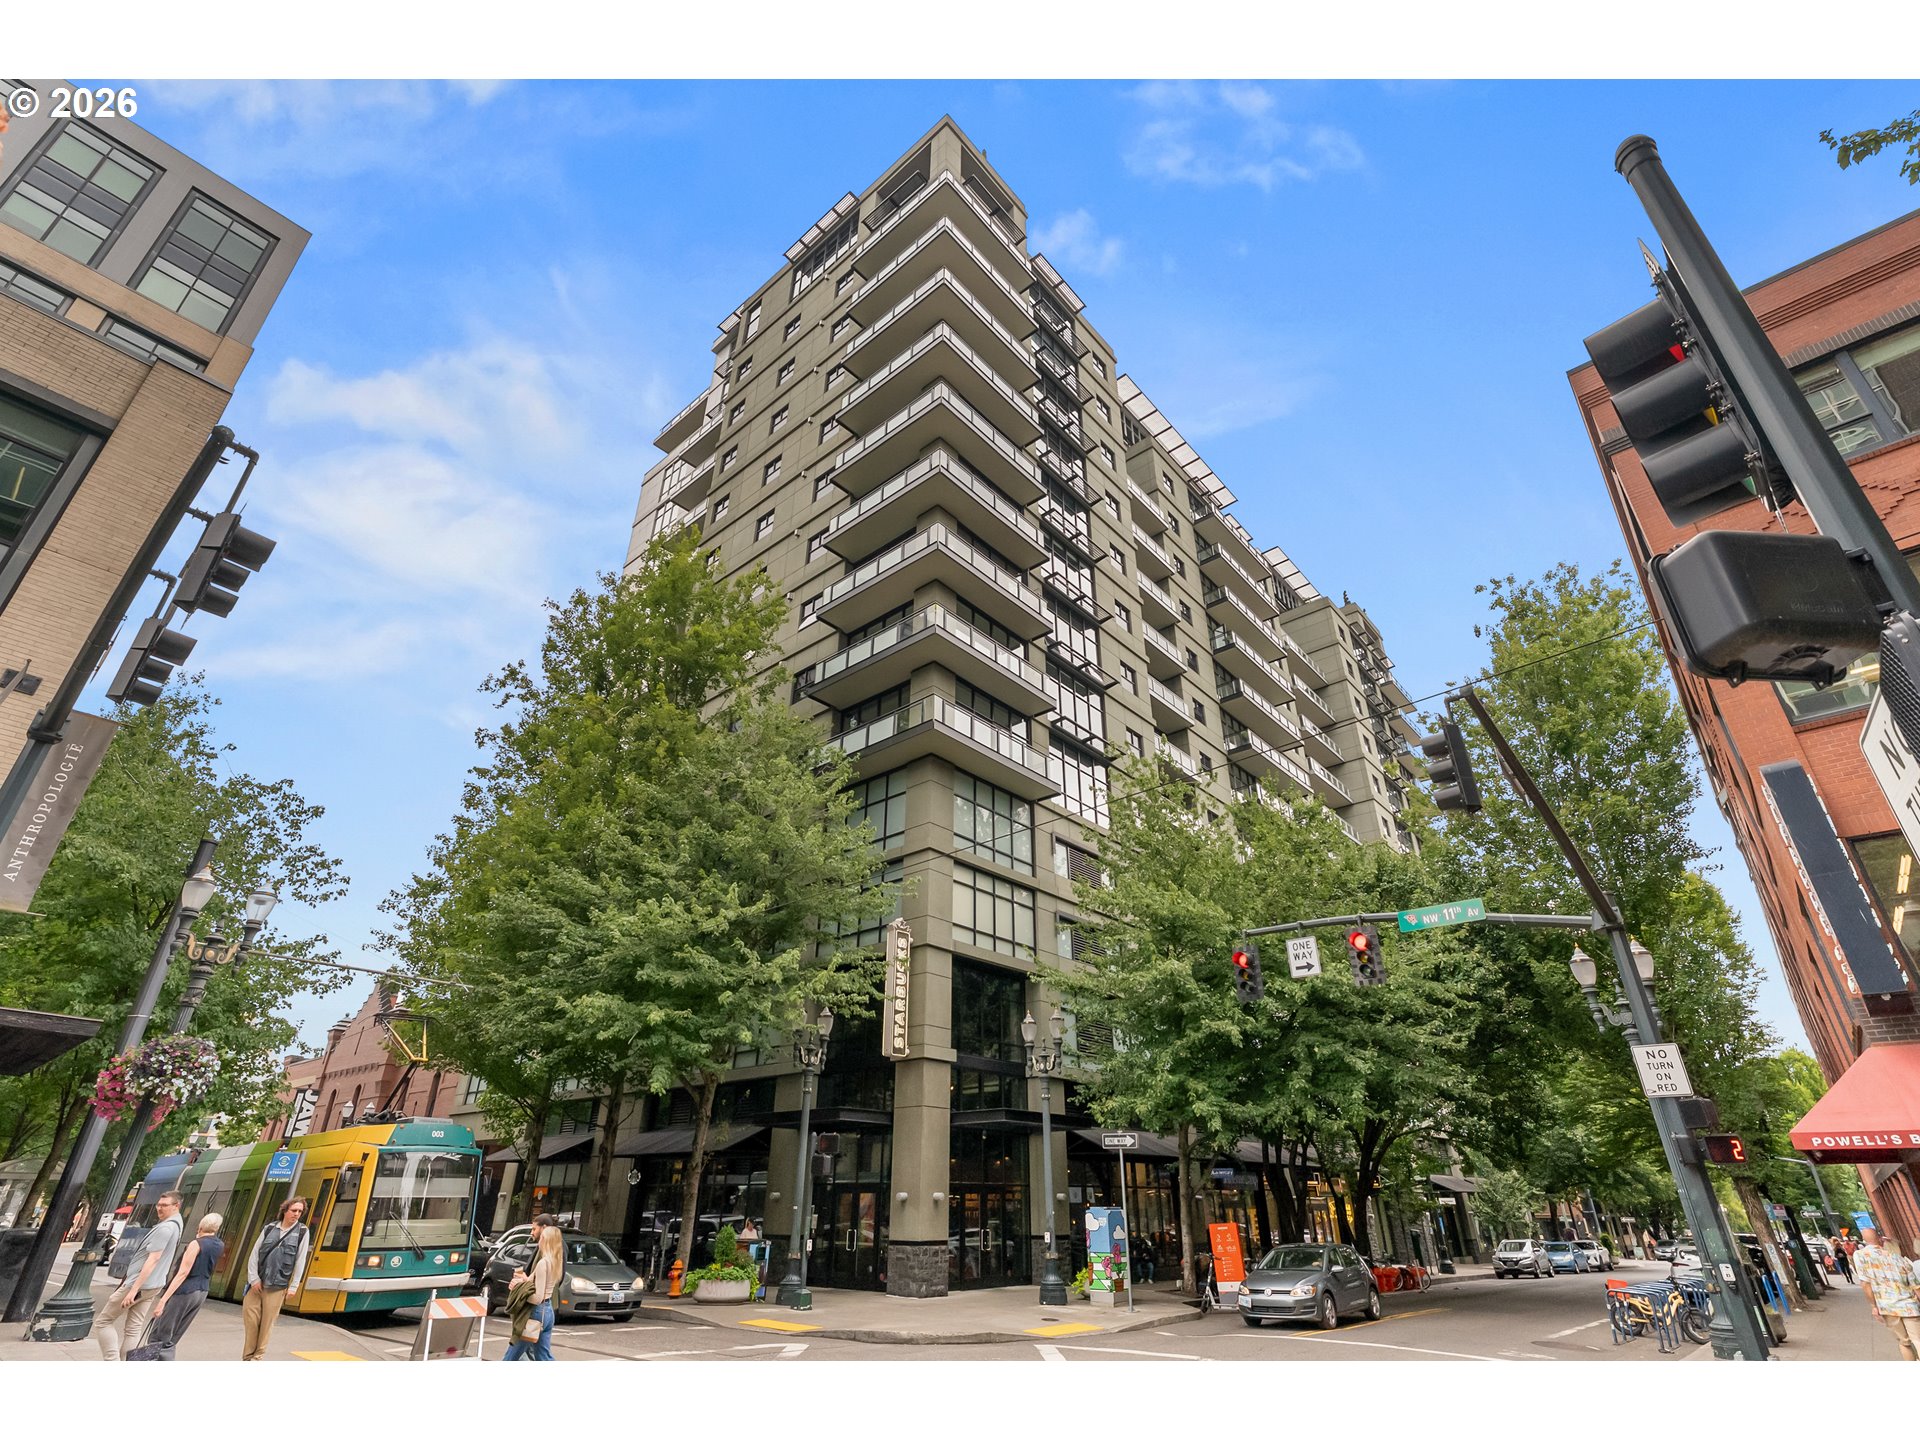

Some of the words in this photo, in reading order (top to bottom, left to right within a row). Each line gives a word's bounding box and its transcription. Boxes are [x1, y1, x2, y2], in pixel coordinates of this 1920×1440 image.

[4, 743, 84, 882] ANTHROPOLOGIE
[1422, 914, 1439, 925] NW
[1442, 906, 1462, 921] 11th
[1467, 907, 1480, 917] Av
[1292, 940, 1312, 951] ONE
[1293, 950, 1314, 961] WAY
[893, 937, 908, 1049] STARBUCKS
[1646, 1049, 1667, 1060] NO
[1646, 1061, 1674, 1070] TURN
[1656, 1072, 1672, 1081] ON
[1657, 1083, 1678, 1092] RED
[432, 1130, 444, 1138] 003
[1811, 1134, 1903, 1147] POWELL'S
[1730, 1140, 1744, 1160] 2
